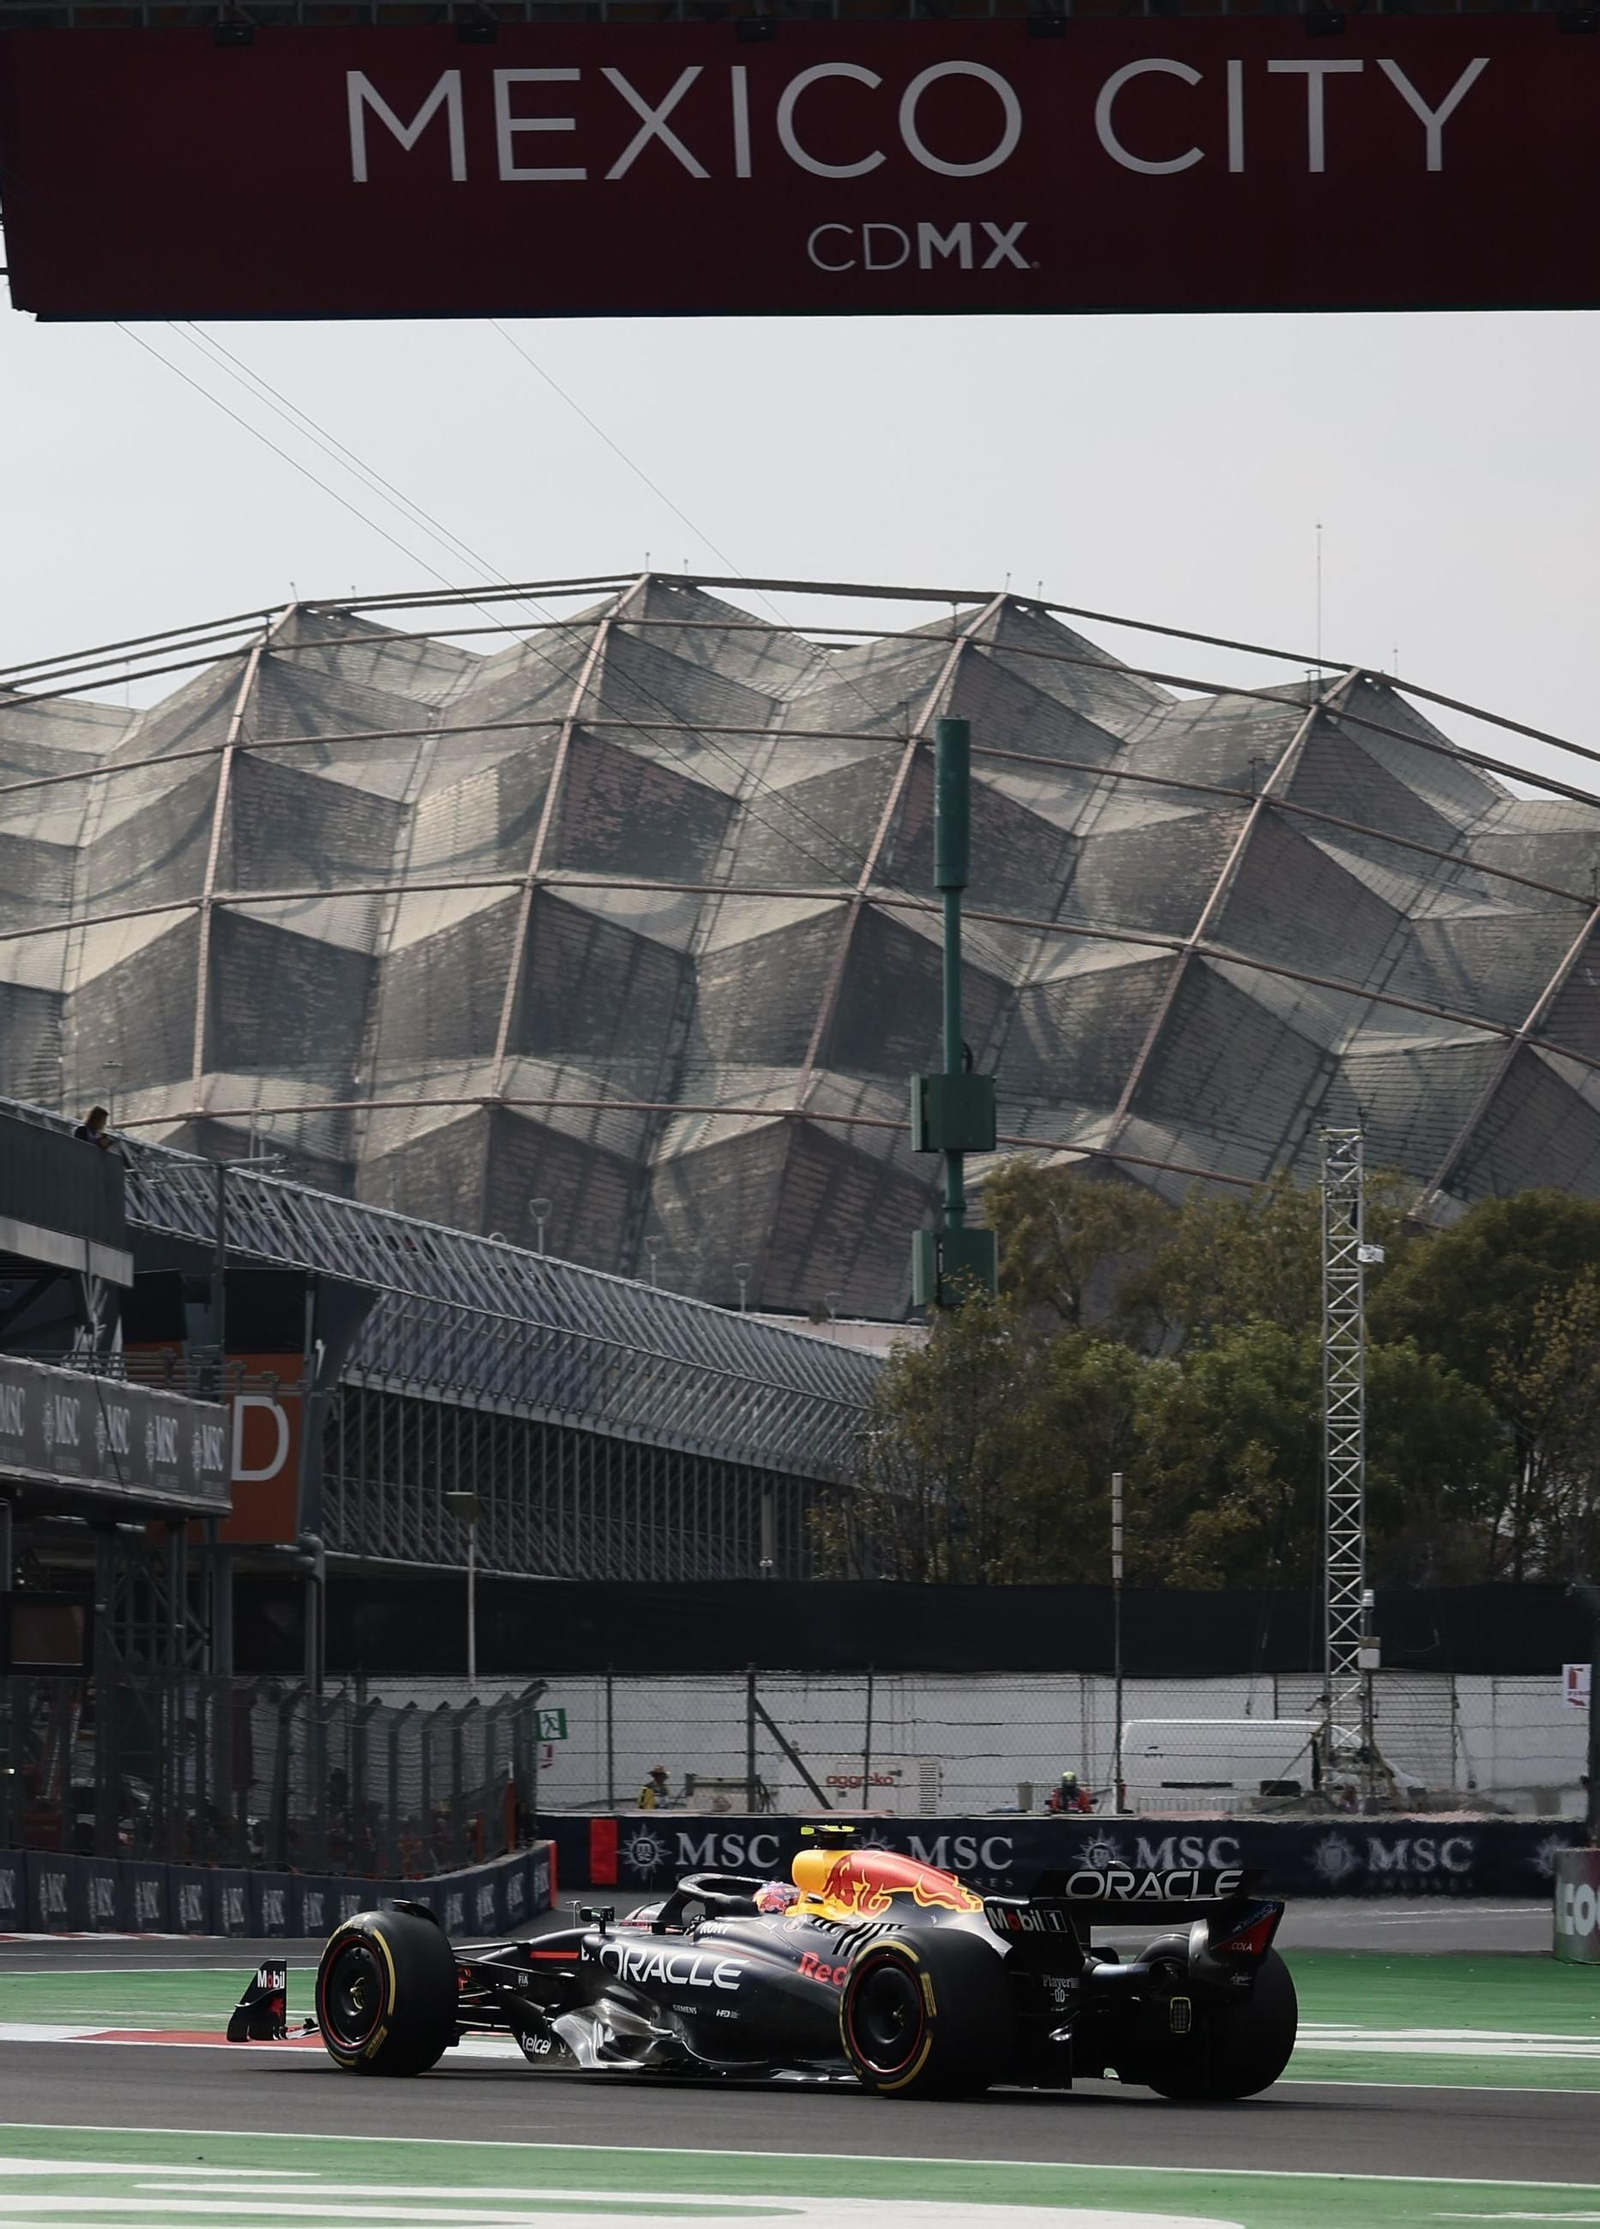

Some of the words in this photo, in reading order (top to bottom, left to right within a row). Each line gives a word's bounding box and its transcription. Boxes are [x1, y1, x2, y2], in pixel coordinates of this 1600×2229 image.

[346, 60, 1022, 183] MEXICO
[1095, 57, 1491, 175] CITY
[807, 220, 1032, 272] CDMX
[231, 1395, 290, 1482] D
[675, 1832, 780, 1868] MSC
[907, 1835, 1014, 1871] MSC
[1135, 1836, 1242, 1869] MSC
[1367, 1836, 1474, 1872] MSC
[1065, 1869, 1244, 1901] ORACLE
[985, 1907, 1045, 1933] Mobil
[257, 1969, 286, 1989] Mobil
[600, 1943, 750, 1990] ORACLE
